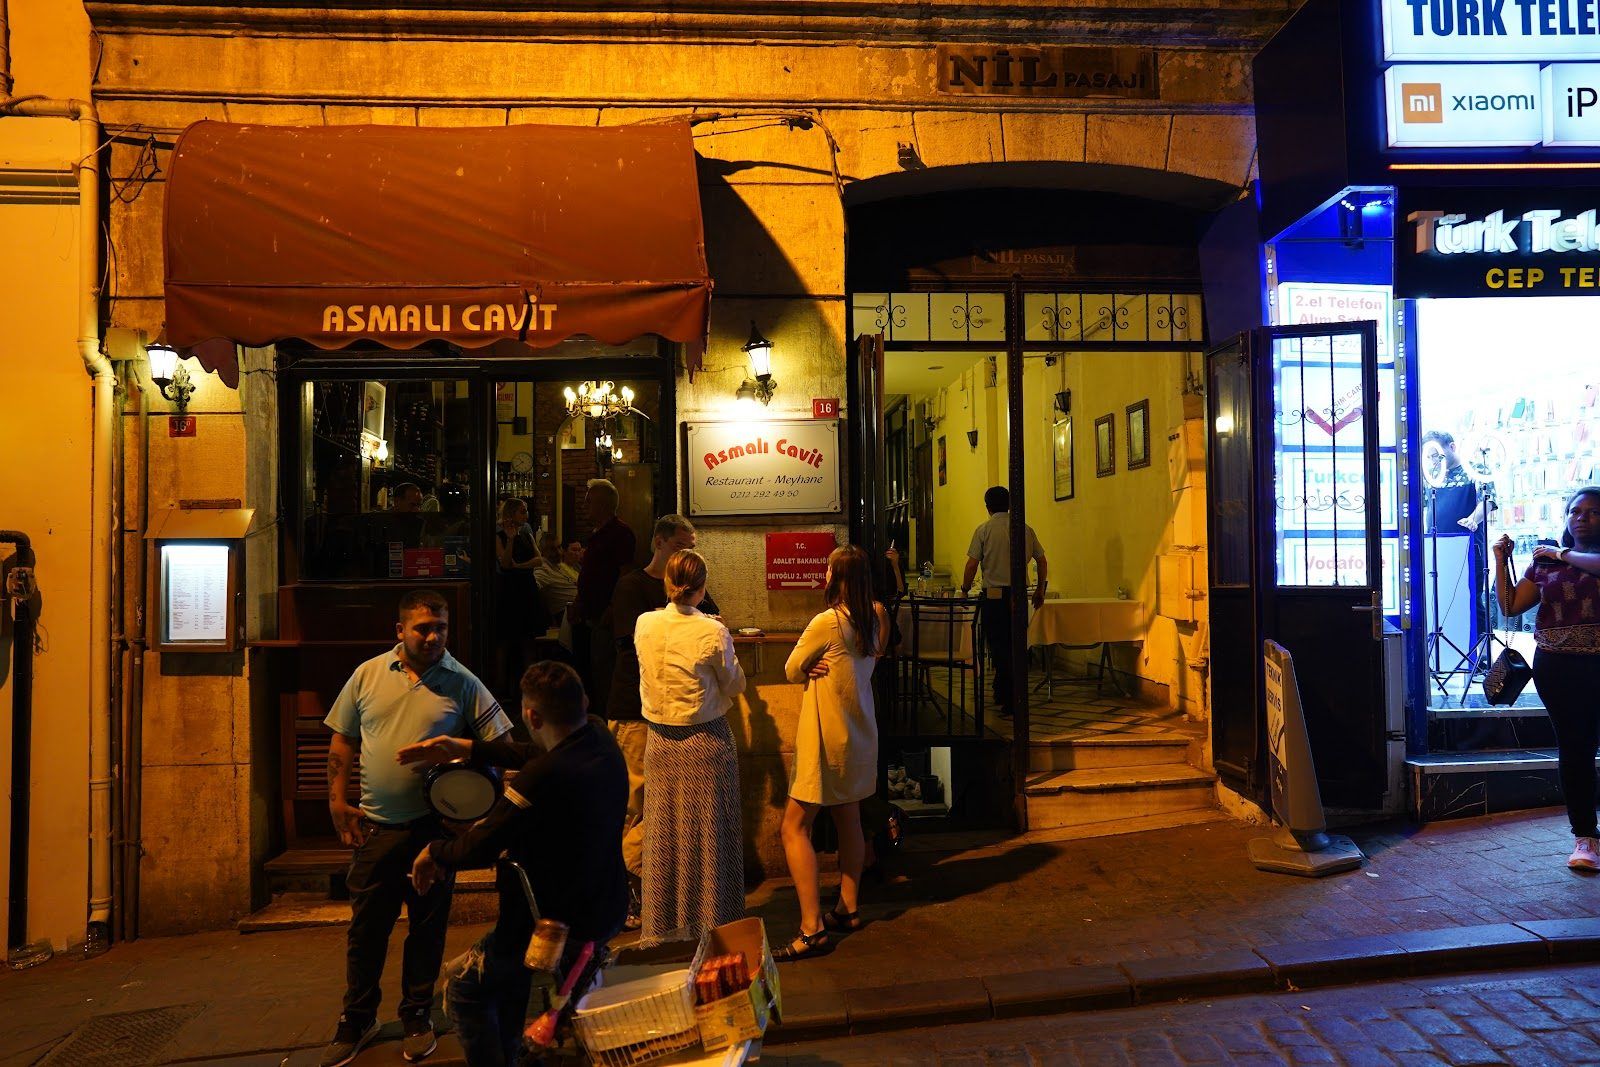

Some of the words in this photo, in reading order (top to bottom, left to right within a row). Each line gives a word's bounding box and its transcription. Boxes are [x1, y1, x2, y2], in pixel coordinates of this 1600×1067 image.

[1514, 0, 1600, 36] TELE
[1407, 208, 1521, 255] Türk
[1523, 208, 1600, 253] Tel
[1485, 267, 1545, 290] CEP
[1559, 267, 1600, 288] TE
[1294, 294, 1323, 308] 2.el
[1327, 296, 1383, 311] Telefon
[321, 303, 451, 332] ASMALI
[819, 402, 832, 414] 16
[703, 437, 769, 471] Asmalı
[775, 439, 824, 469] Cavit
[705, 476, 765, 487] Restaurant
[774, 474, 824, 487] Meyhane
[1302, 468, 1384, 484] Turkcl
[730, 491, 751, 499] 0212
[753, 490, 771, 498] 292
[773, 490, 785, 498] 49
[786, 489, 800, 498] 50
[794, 542, 807, 550] T.C.
[772, 557, 796, 565] ADALET
[1303, 555, 1386, 570] Vodafoe
[767, 571, 795, 580] BEYOĞLU
[802, 572, 826, 580] NOTERL
